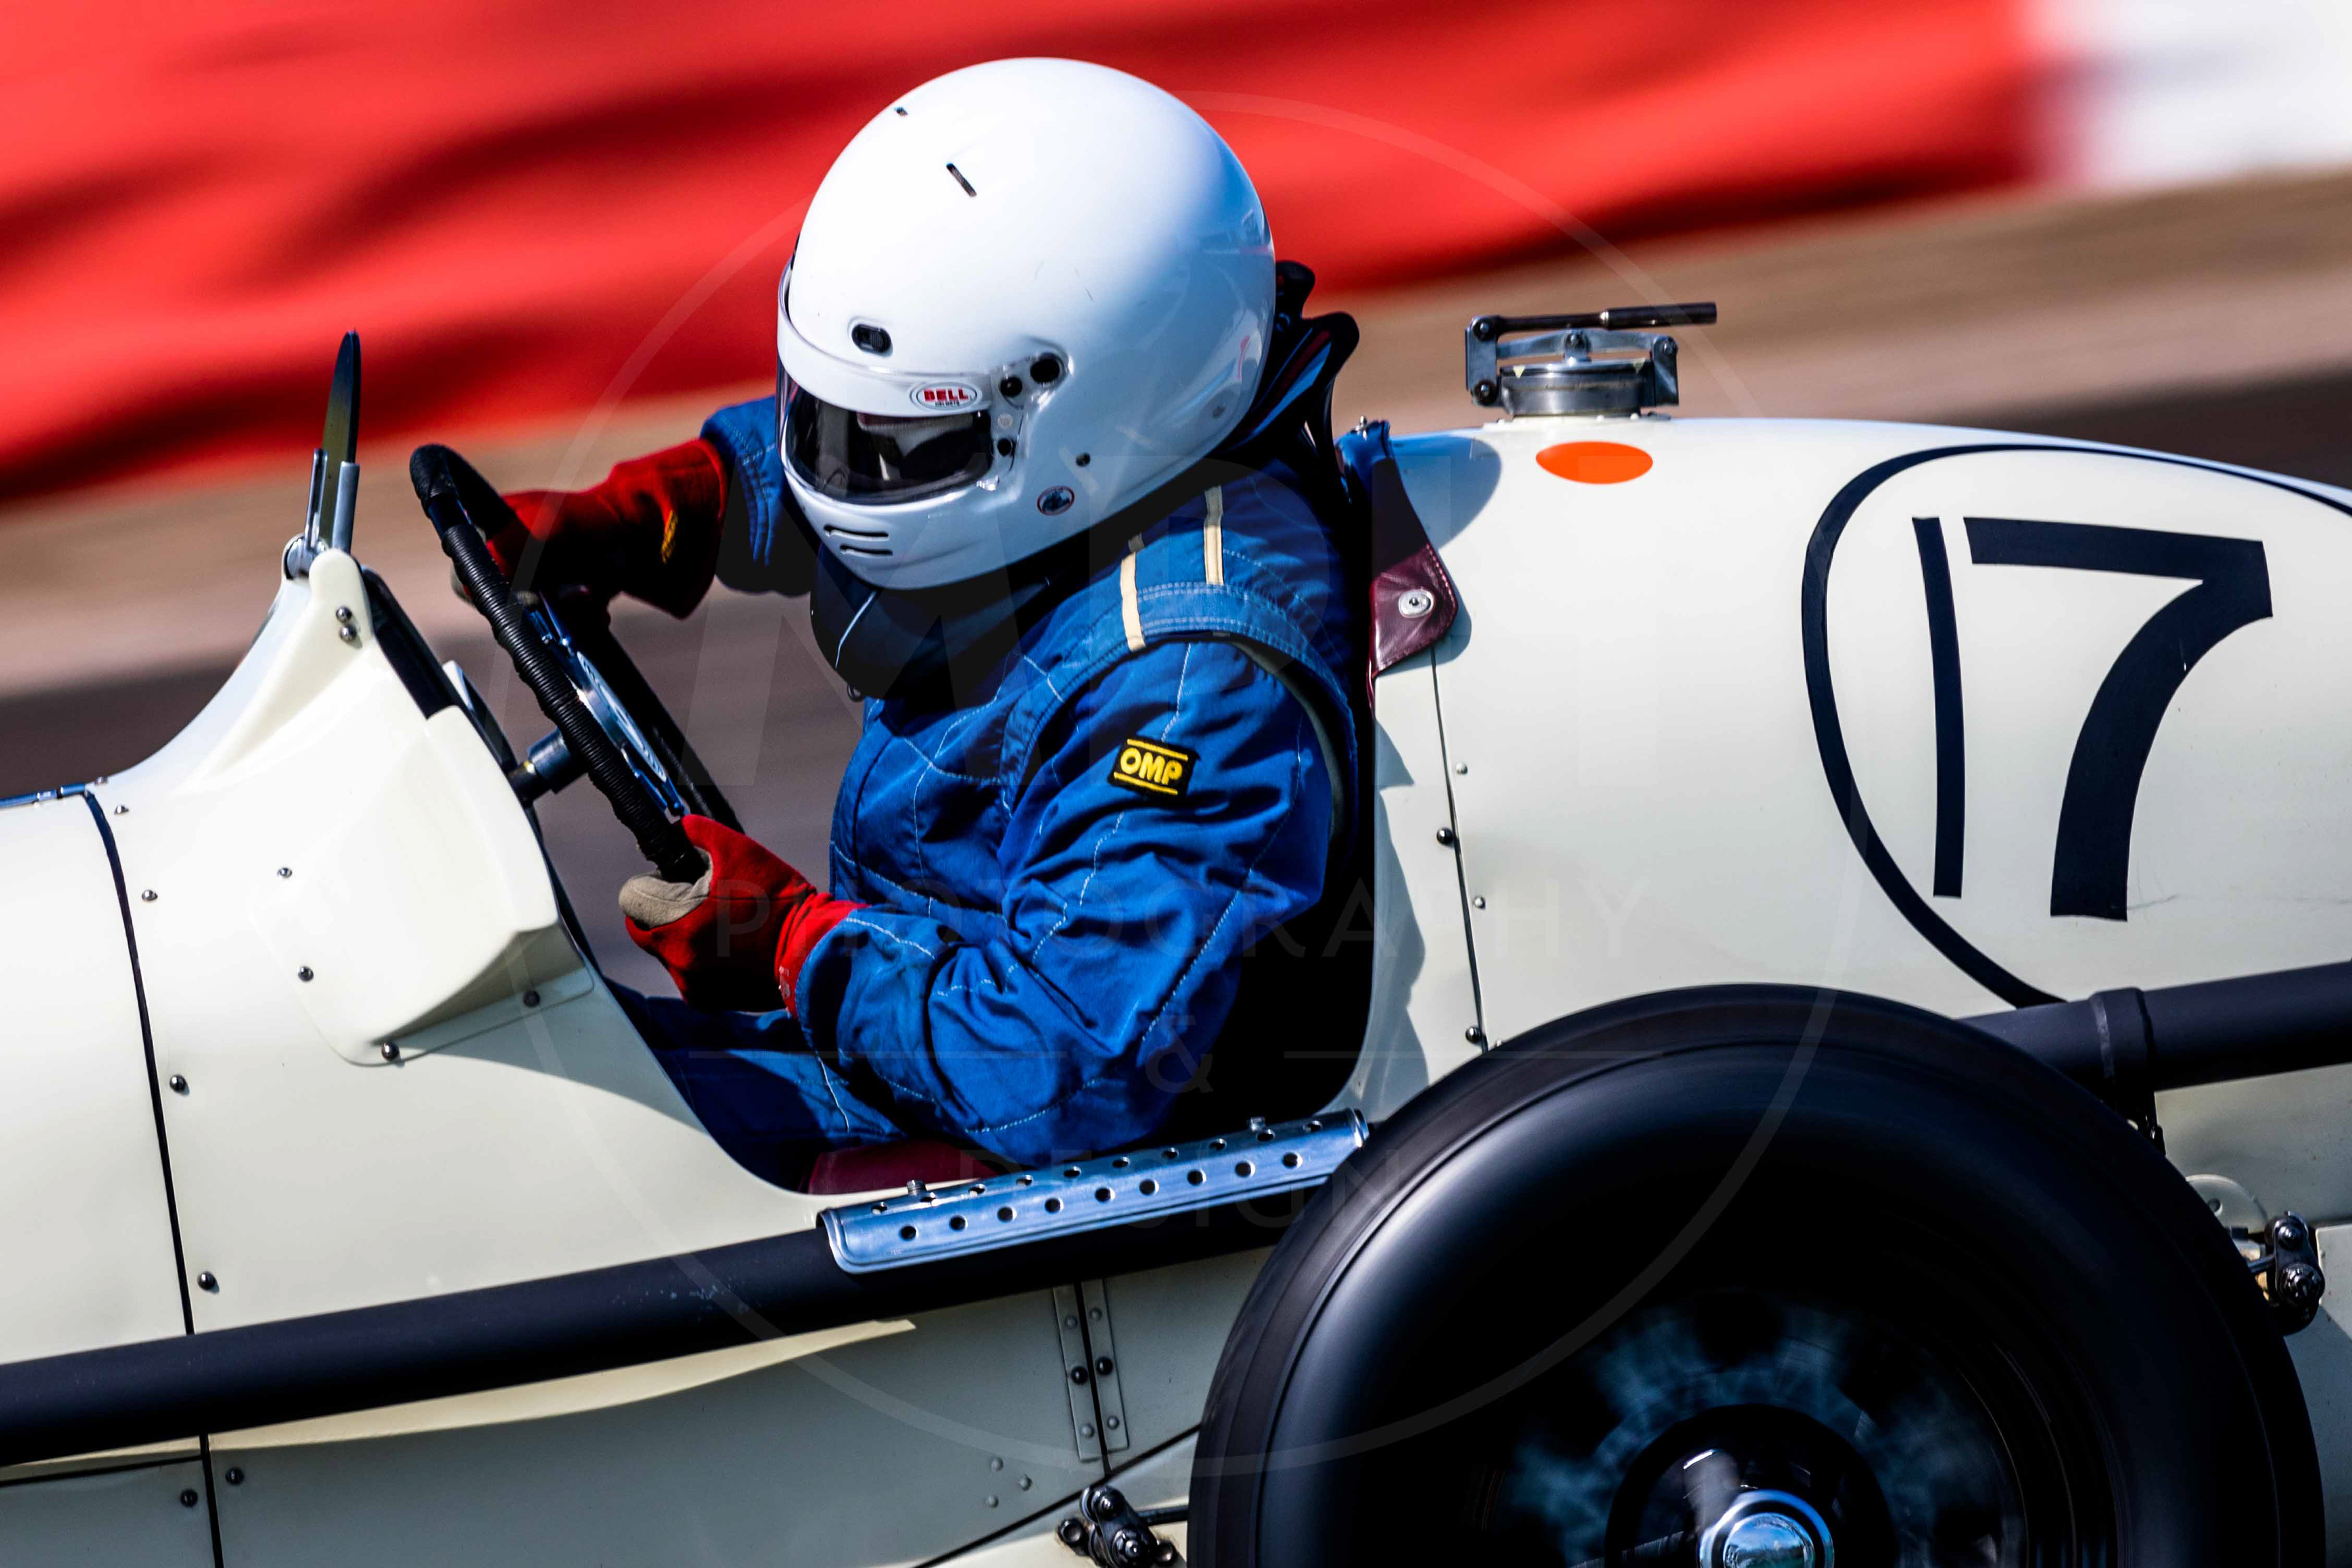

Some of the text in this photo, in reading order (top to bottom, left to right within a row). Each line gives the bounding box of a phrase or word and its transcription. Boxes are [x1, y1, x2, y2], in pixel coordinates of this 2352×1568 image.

[924, 388, 969, 401] BELL
[1912, 516, 2273, 922] 17
[1120, 747, 1182, 785] OMP
